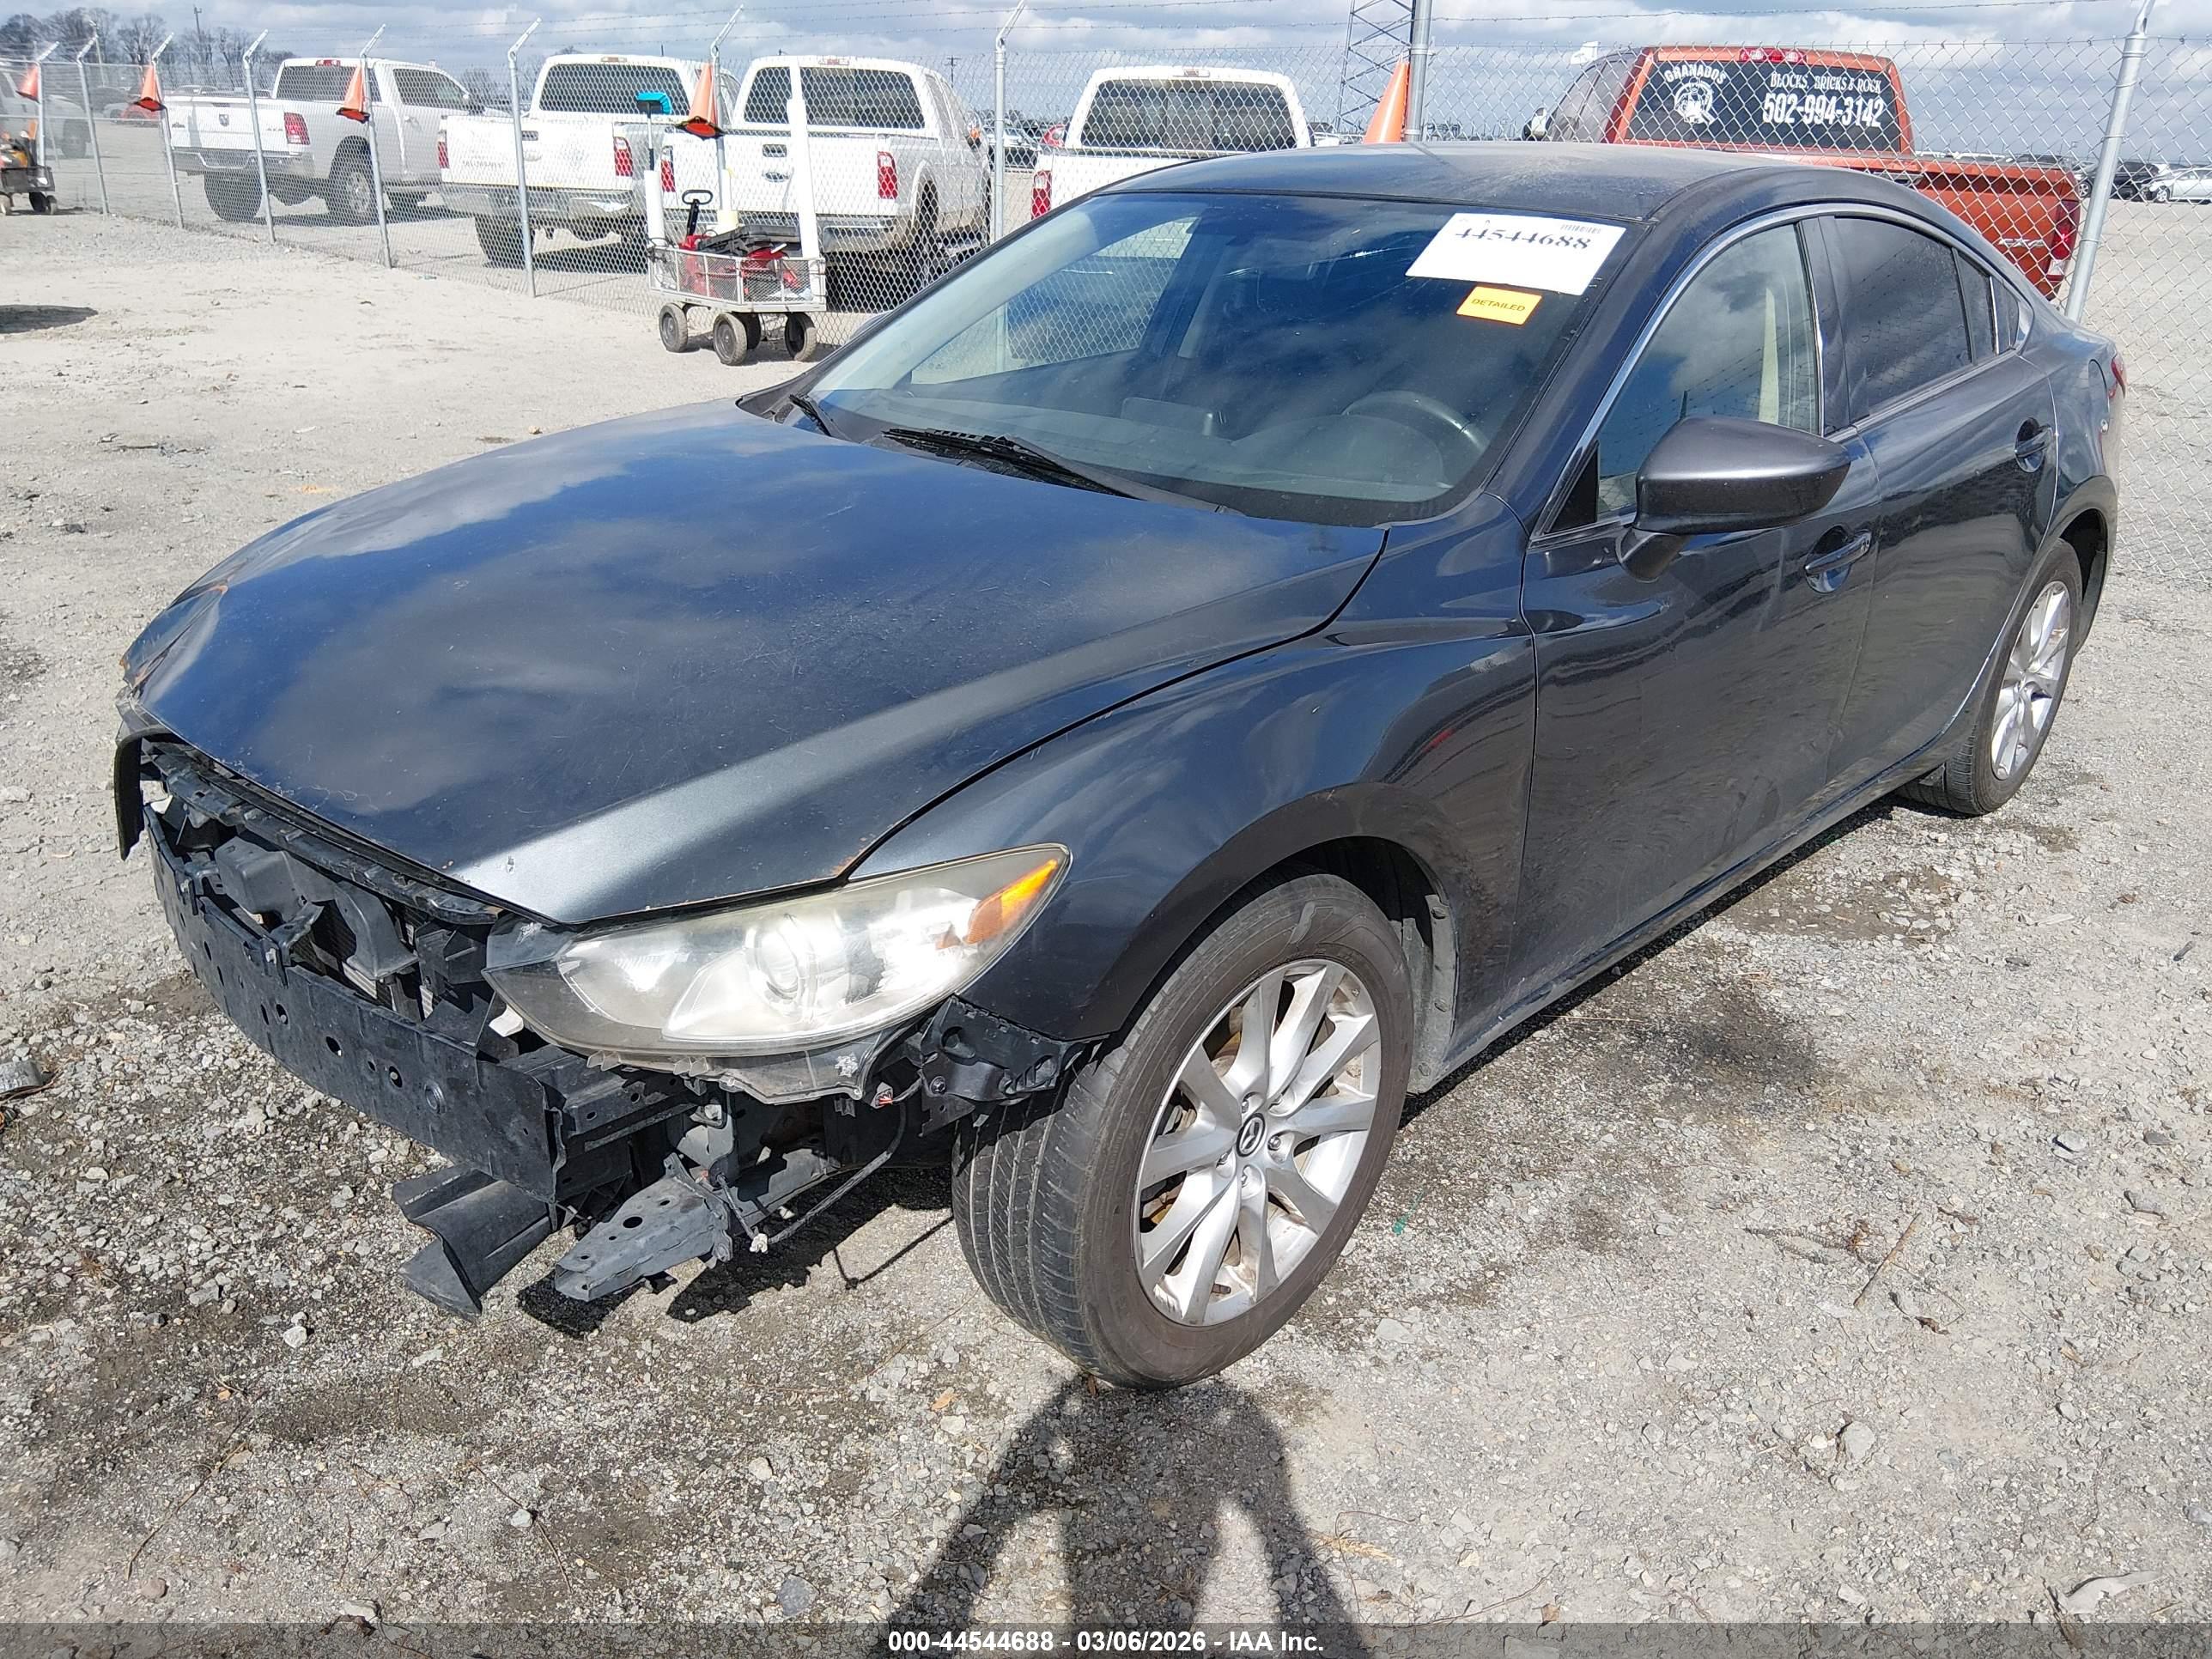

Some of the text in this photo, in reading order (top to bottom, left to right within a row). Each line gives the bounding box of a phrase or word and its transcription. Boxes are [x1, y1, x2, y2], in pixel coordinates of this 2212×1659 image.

[1664, 64, 1726, 84] GRANADOS
[1814, 76, 1846, 91] BRICKS
[1857, 78, 1881, 94] ROCK
[1762, 93, 1885, 127] 502-994-3142
[1455, 228, 1591, 249] 44544688
[1472, 298, 1525, 312] DETAILED
